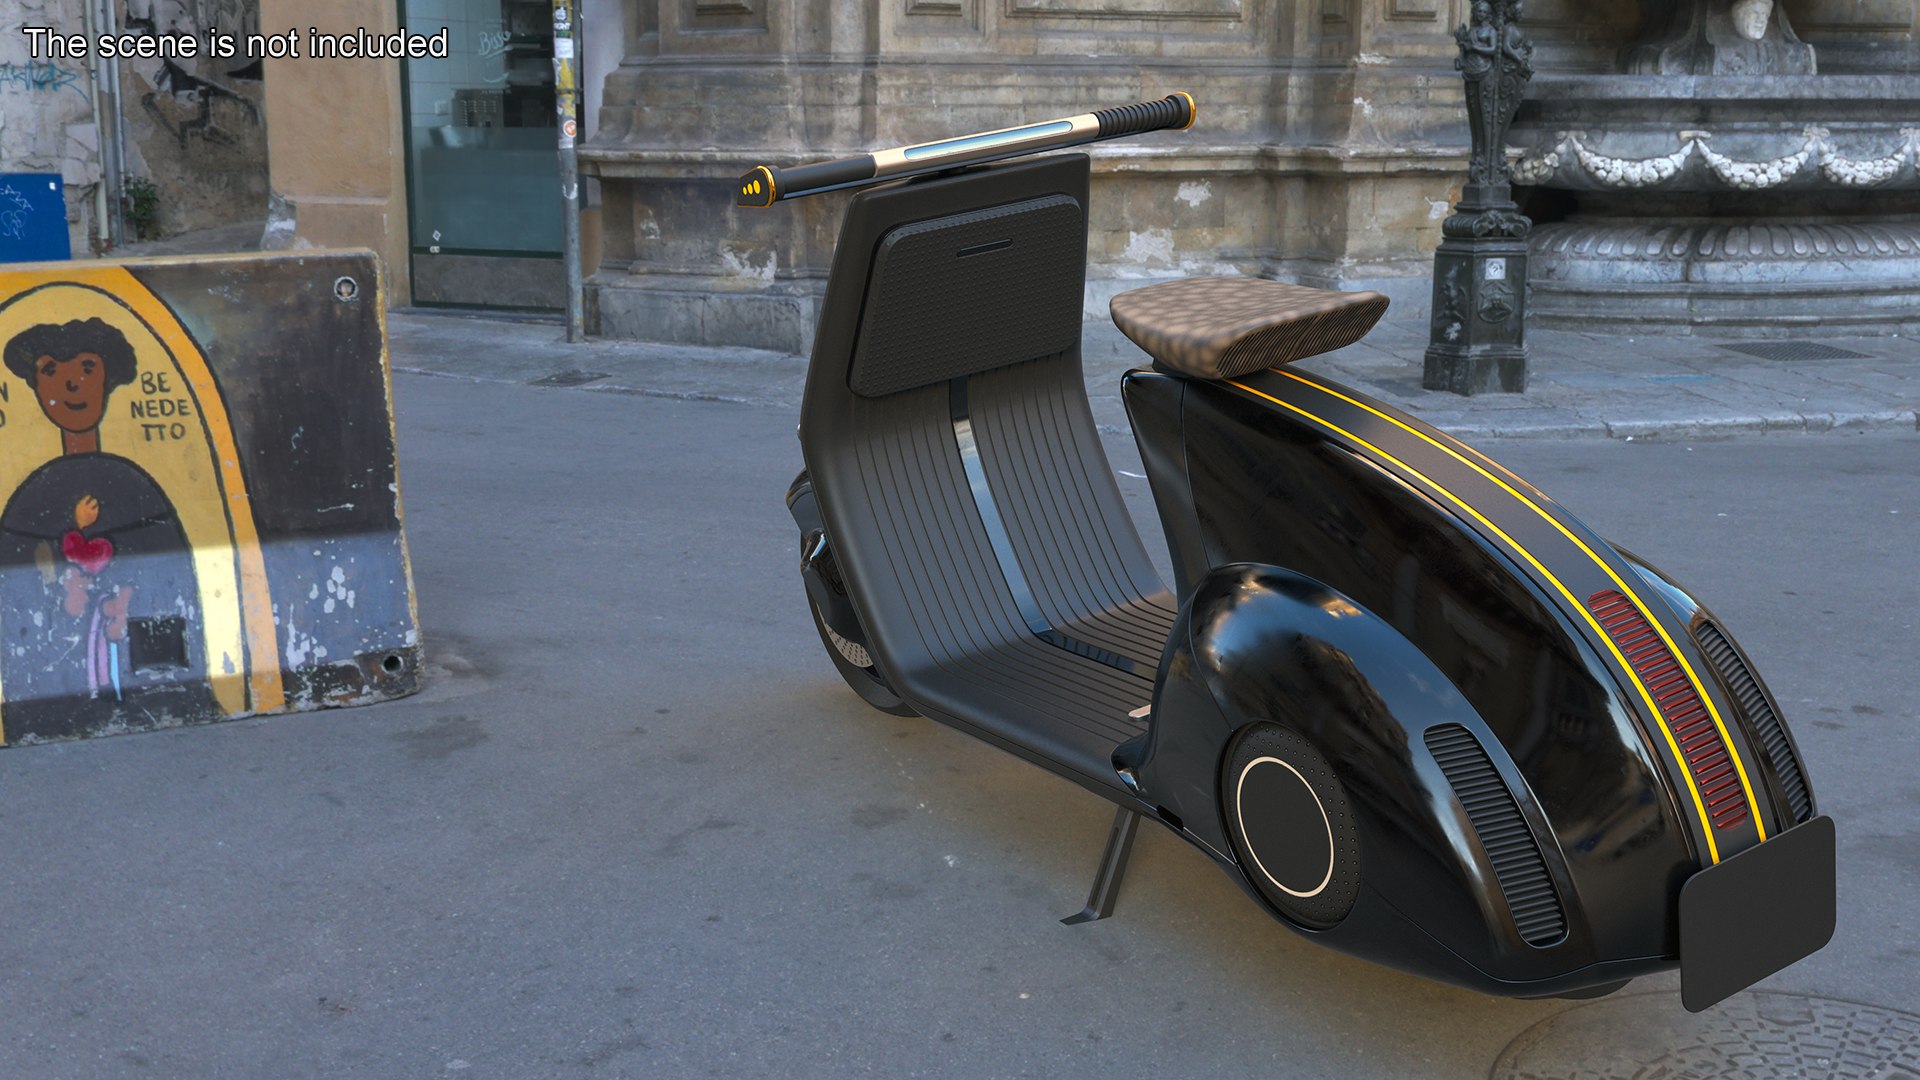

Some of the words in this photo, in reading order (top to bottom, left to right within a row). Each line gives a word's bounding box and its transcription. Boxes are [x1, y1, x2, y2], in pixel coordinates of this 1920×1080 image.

[141, 371, 171, 394] BE
[131, 399, 191, 418] NEDE
[141, 422, 186, 441] TTO
